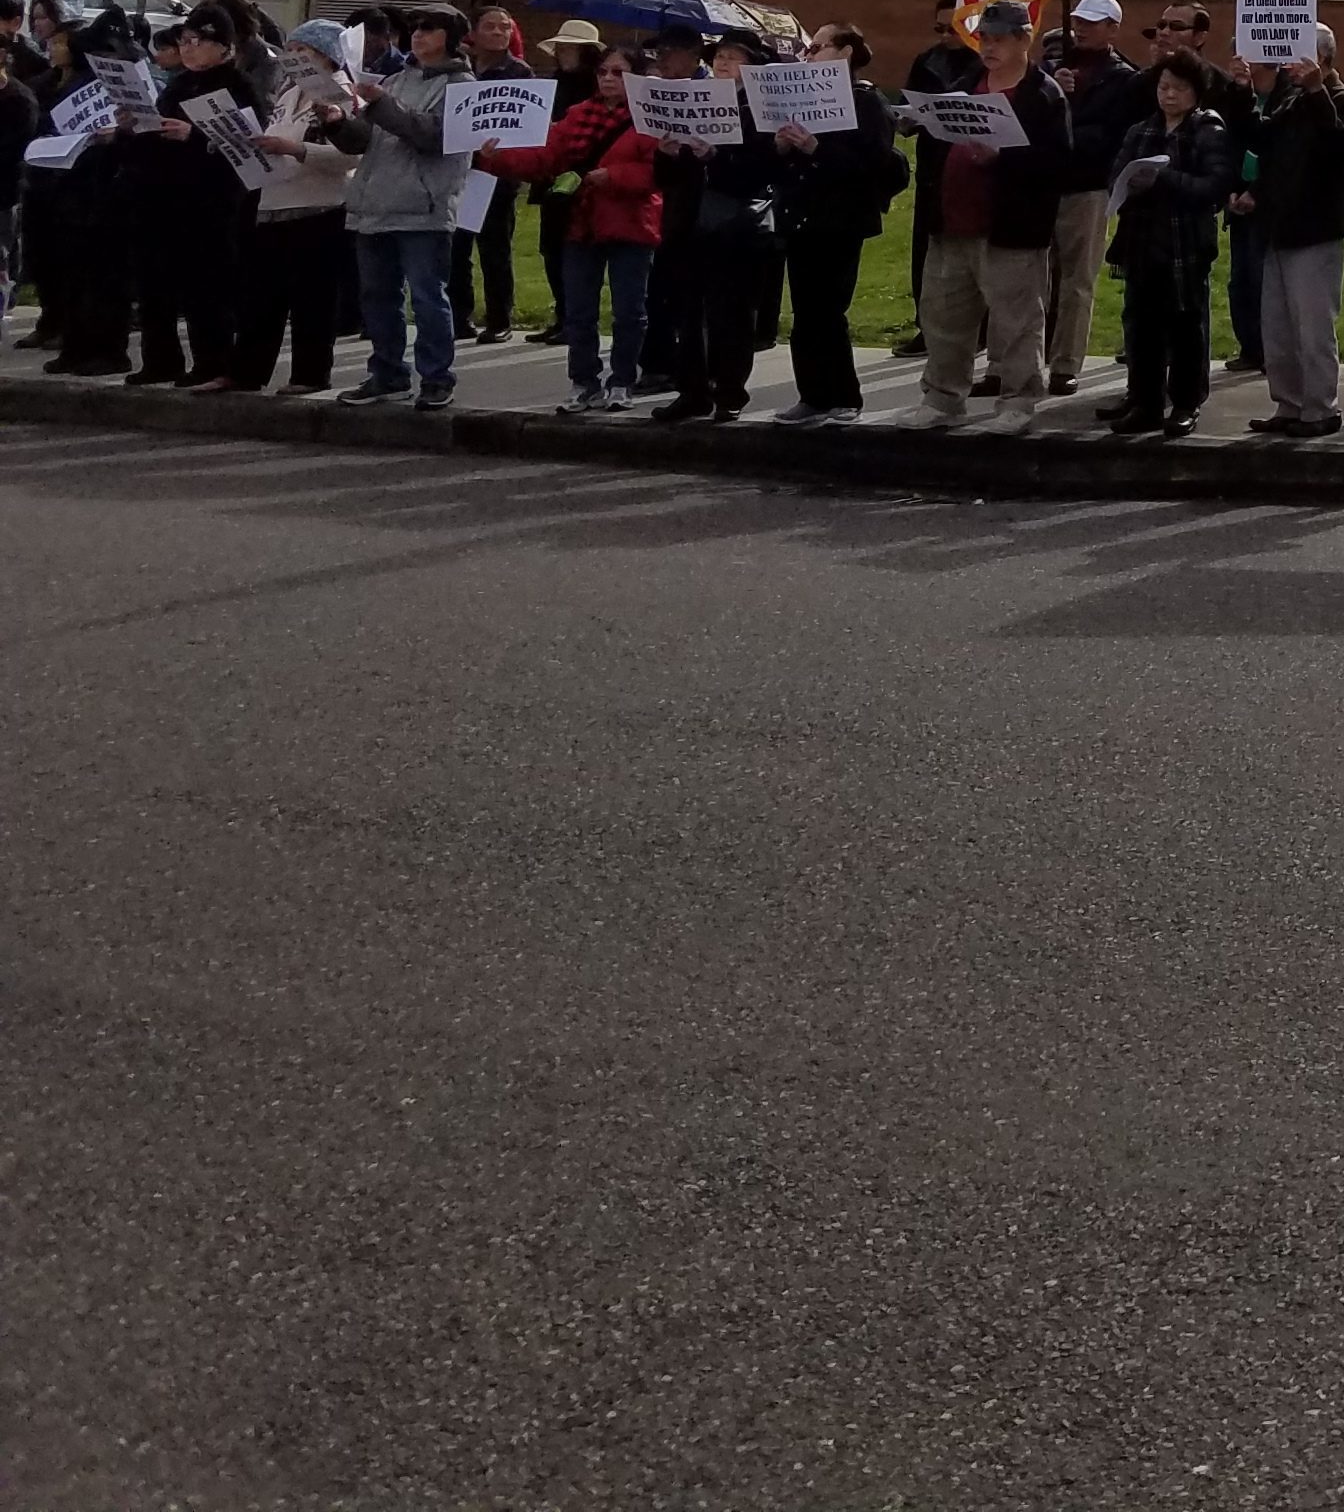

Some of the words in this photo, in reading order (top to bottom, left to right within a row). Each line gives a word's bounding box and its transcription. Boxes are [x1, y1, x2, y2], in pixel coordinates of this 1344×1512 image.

[1255, 12, 1272, 23] Lord
[1274, 14, 1284, 23] no
[1286, 14, 1312, 23] more.
[1251, 29, 1268, 40] OUR
[1269, 29, 1288, 40] LADY
[1290, 29, 1299, 40] OF
[1263, 45, 1292, 56] FATIMA
[751, 72, 779, 82] MARY
[784, 69, 818, 81] HELP
[822, 67, 839, 77] OF
[760, 81, 833, 95] CHRISTIANS
[455, 97, 474, 114] ST.
[478, 86, 546, 110] MICHAEL
[650, 89, 690, 102] KEEP
[694, 92, 710, 102] IT
[472, 102, 526, 117] DEFEAT
[636, 101, 669, 118] "ONE
[674, 107, 738, 118] NATION
[762, 110, 789, 122] JESUS
[792, 107, 846, 124] CHRIST
[933, 100, 1012, 117] MICHAEL
[472, 118, 523, 131] SATAN.
[936, 113, 988, 123] DEFEAT
[644, 118, 691, 134] UNDER
[696, 123, 739, 134] GOD"
